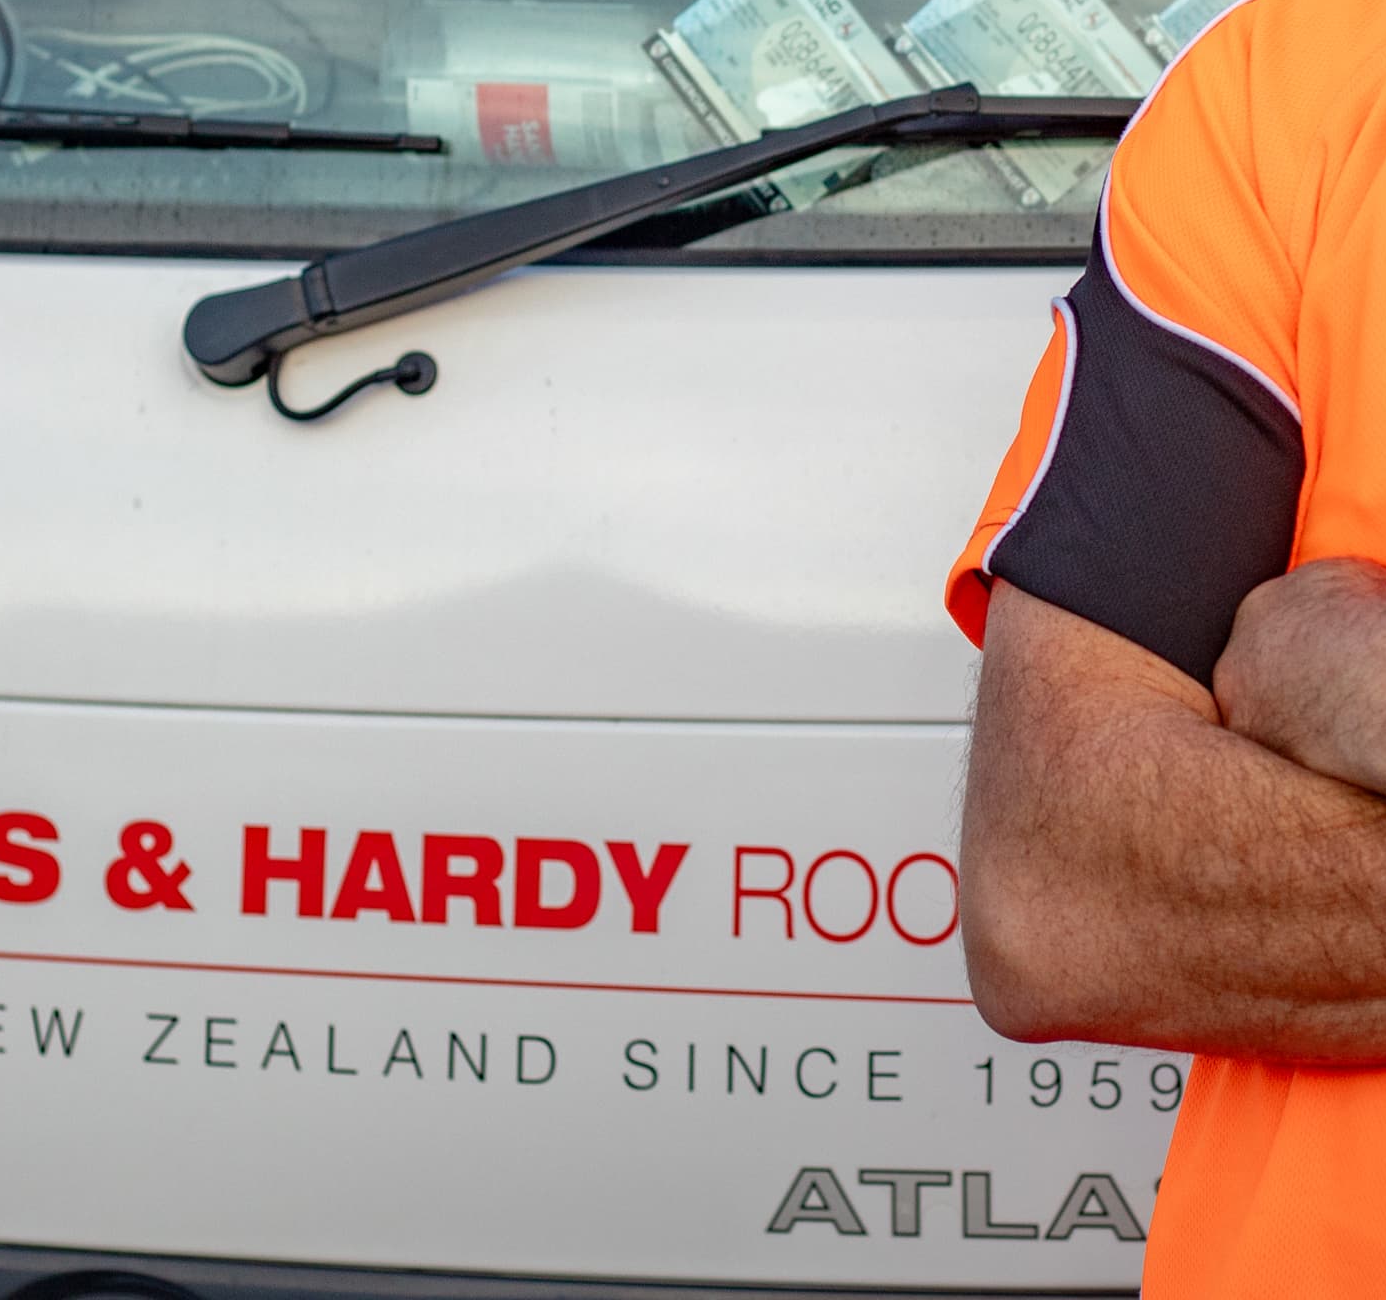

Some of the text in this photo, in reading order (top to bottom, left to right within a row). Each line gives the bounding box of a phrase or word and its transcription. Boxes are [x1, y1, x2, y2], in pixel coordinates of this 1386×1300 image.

[104, 819, 193, 912] &
[240, 825, 690, 934] HARDY
[732, 846, 960, 947] ROO
[140, 1013, 557, 1085] ZEALAND
[621, 1038, 903, 1102] SINCE
[974, 1056, 1184, 1114] 1959
[765, 1166, 1165, 1244] ATLA
